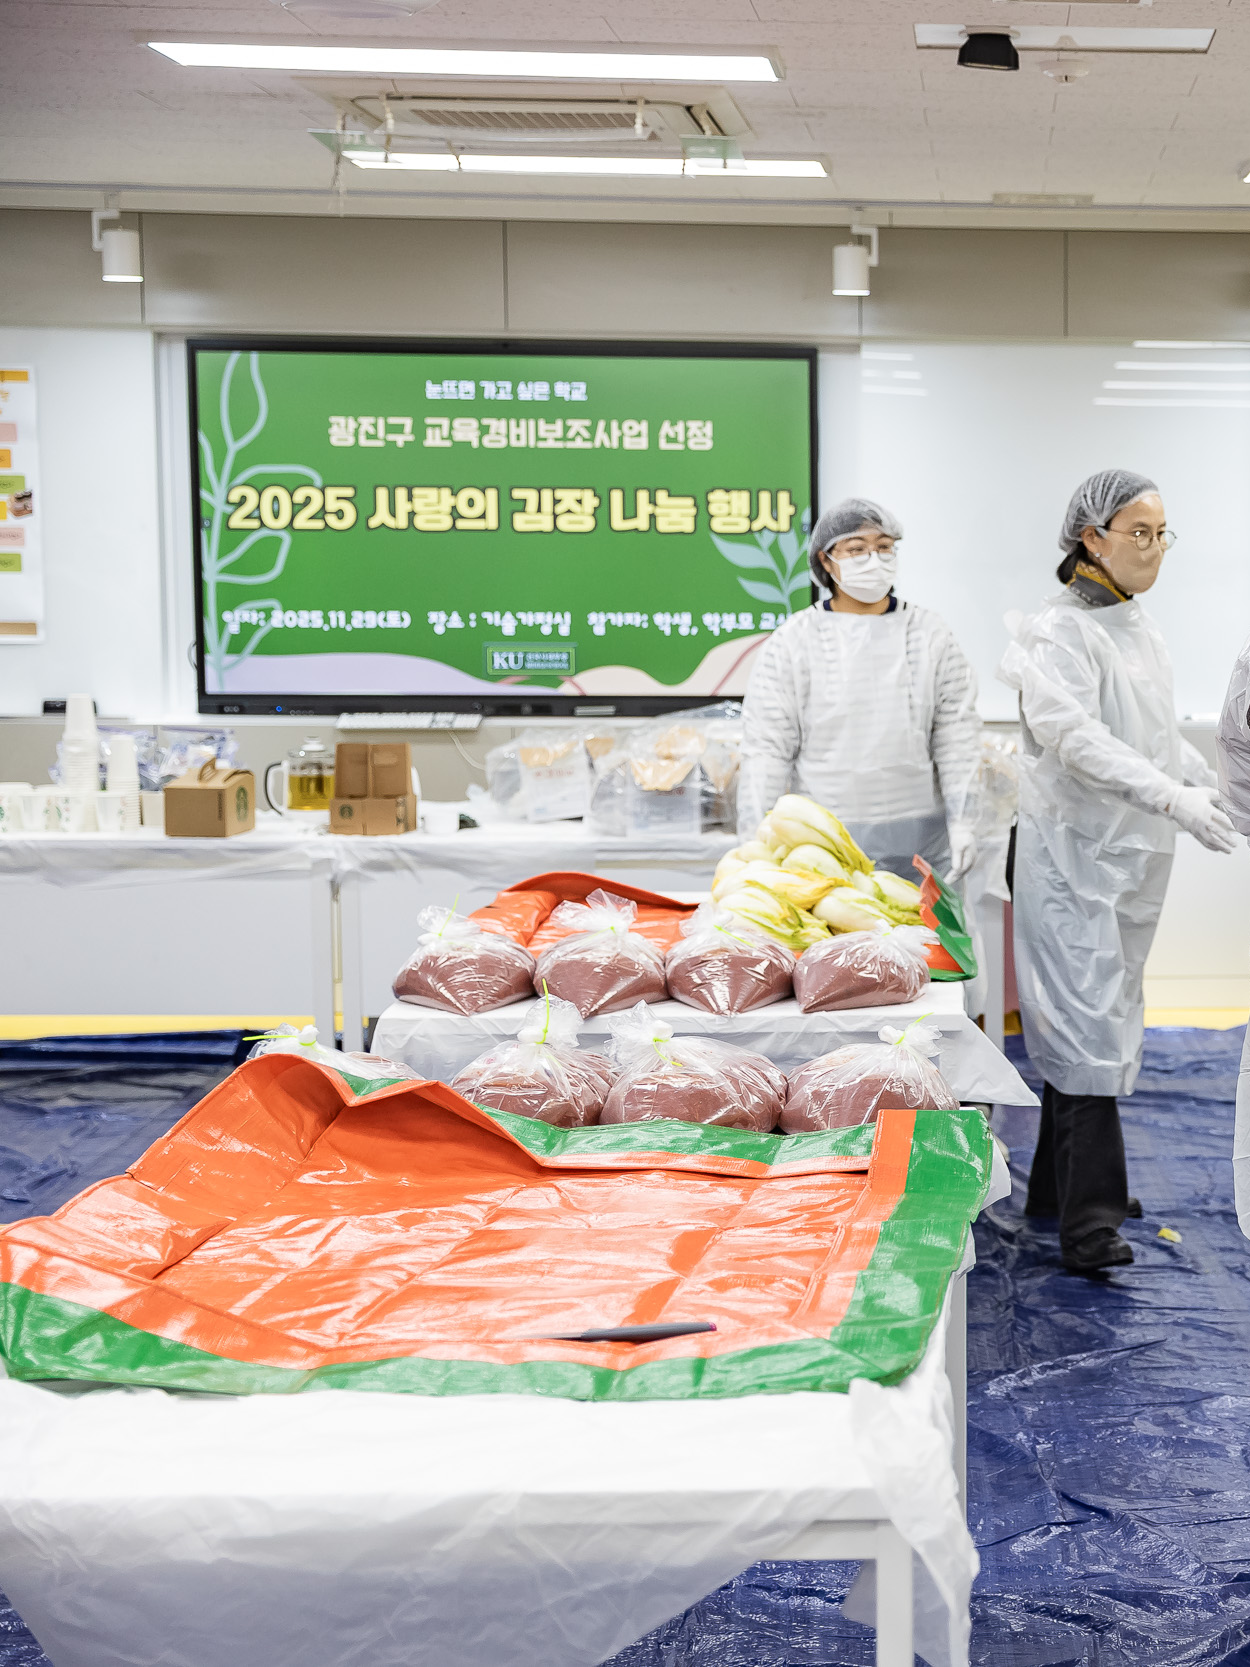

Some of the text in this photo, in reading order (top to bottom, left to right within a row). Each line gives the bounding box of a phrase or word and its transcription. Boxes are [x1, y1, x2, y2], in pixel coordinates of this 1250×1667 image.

[479, 380, 514, 400] 가고
[516, 380, 551, 401] 싶은
[553, 380, 589, 402] 학교
[327, 415, 714, 451] 광진구 교육경비보조사업 선정
[226, 484, 796, 535] 2025 사랑의 김장 나눔 행사
[427, 610, 466, 636] 장소
[480, 610, 572, 637] 기술가정실
[701, 611, 756, 637] 학부모
[493, 651, 525, 670] KU
